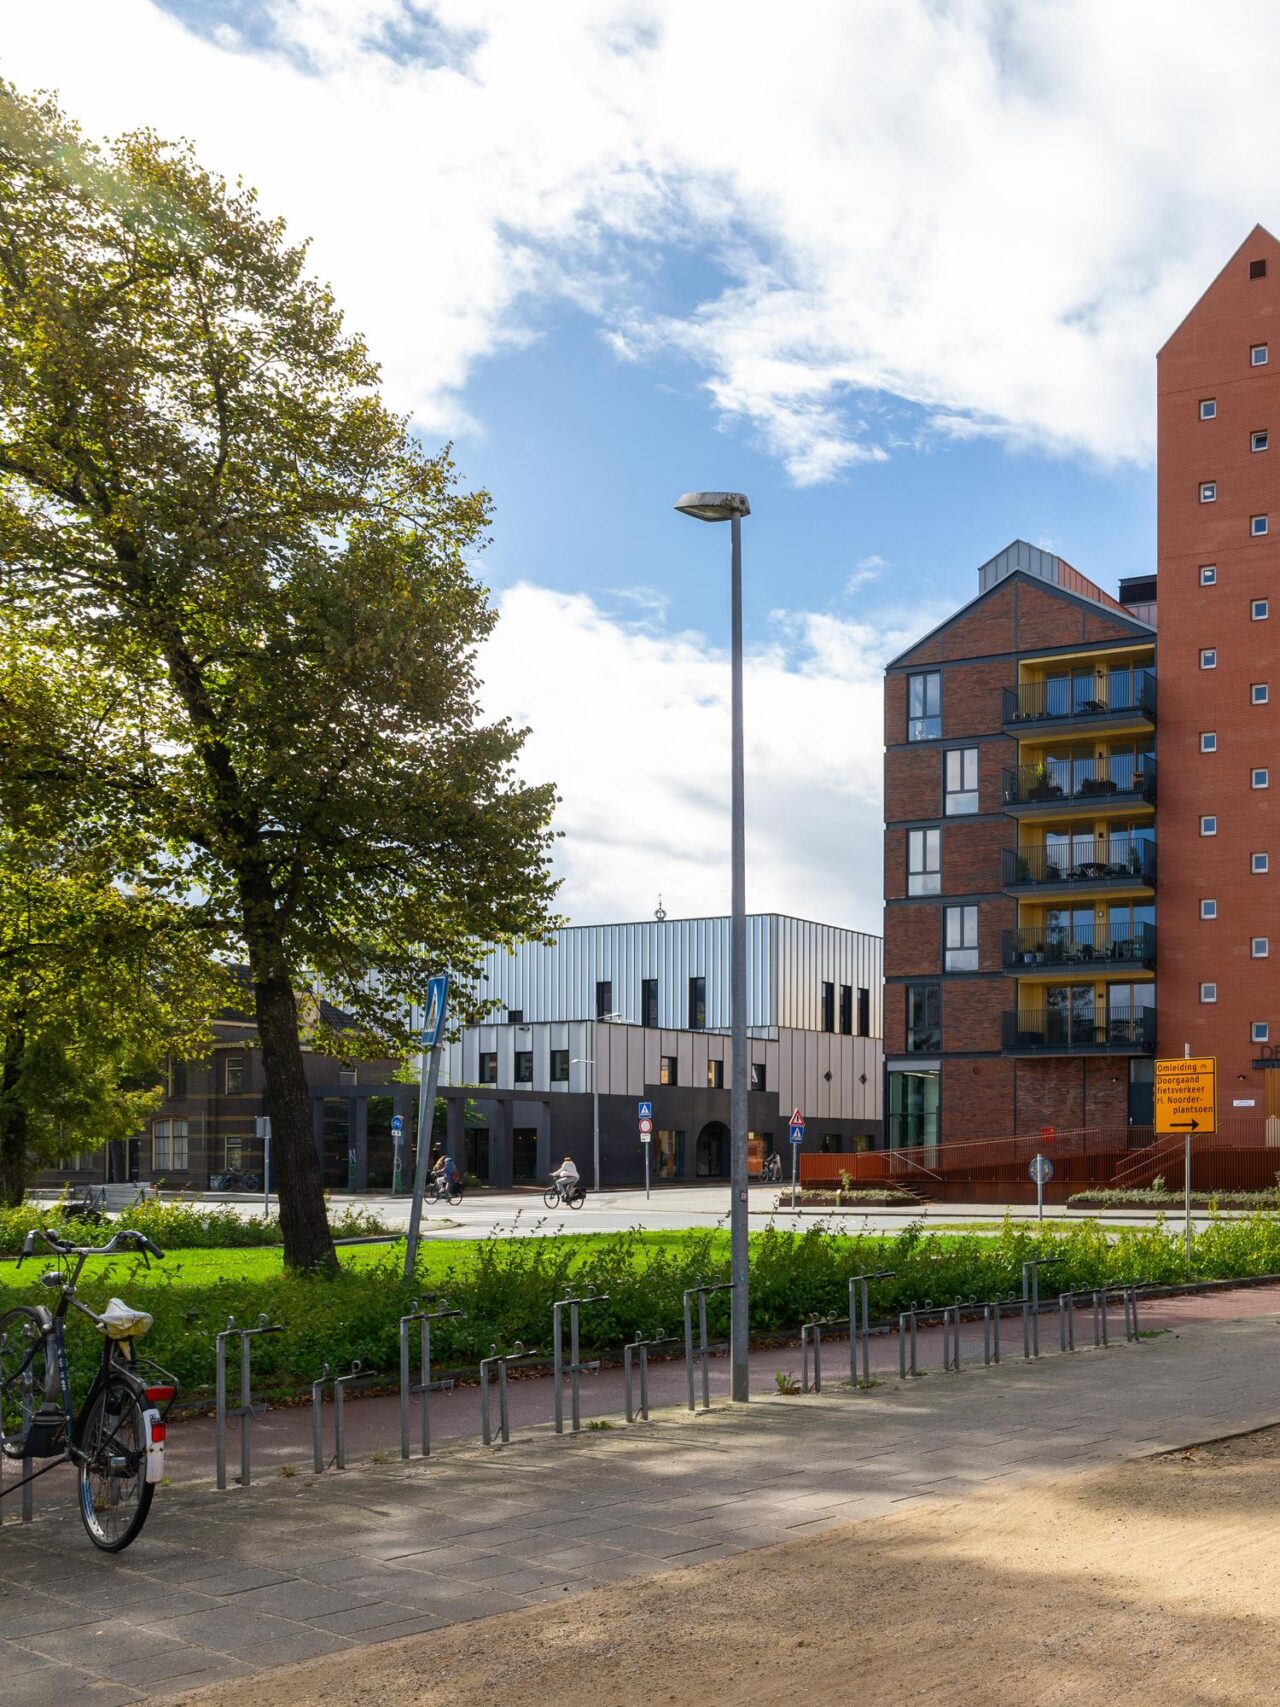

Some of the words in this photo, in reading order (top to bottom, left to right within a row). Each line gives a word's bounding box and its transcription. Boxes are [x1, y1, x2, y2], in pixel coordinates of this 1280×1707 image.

[1157, 1063, 1197, 1072] Omleiding
[1157, 1076, 1200, 1085] Doorgaand
[1157, 1086, 1205, 1094] fietsverkeer
[1167, 1096, 1203, 1104] Noorder-
[1173, 1106, 1213, 1115] plantsoen
